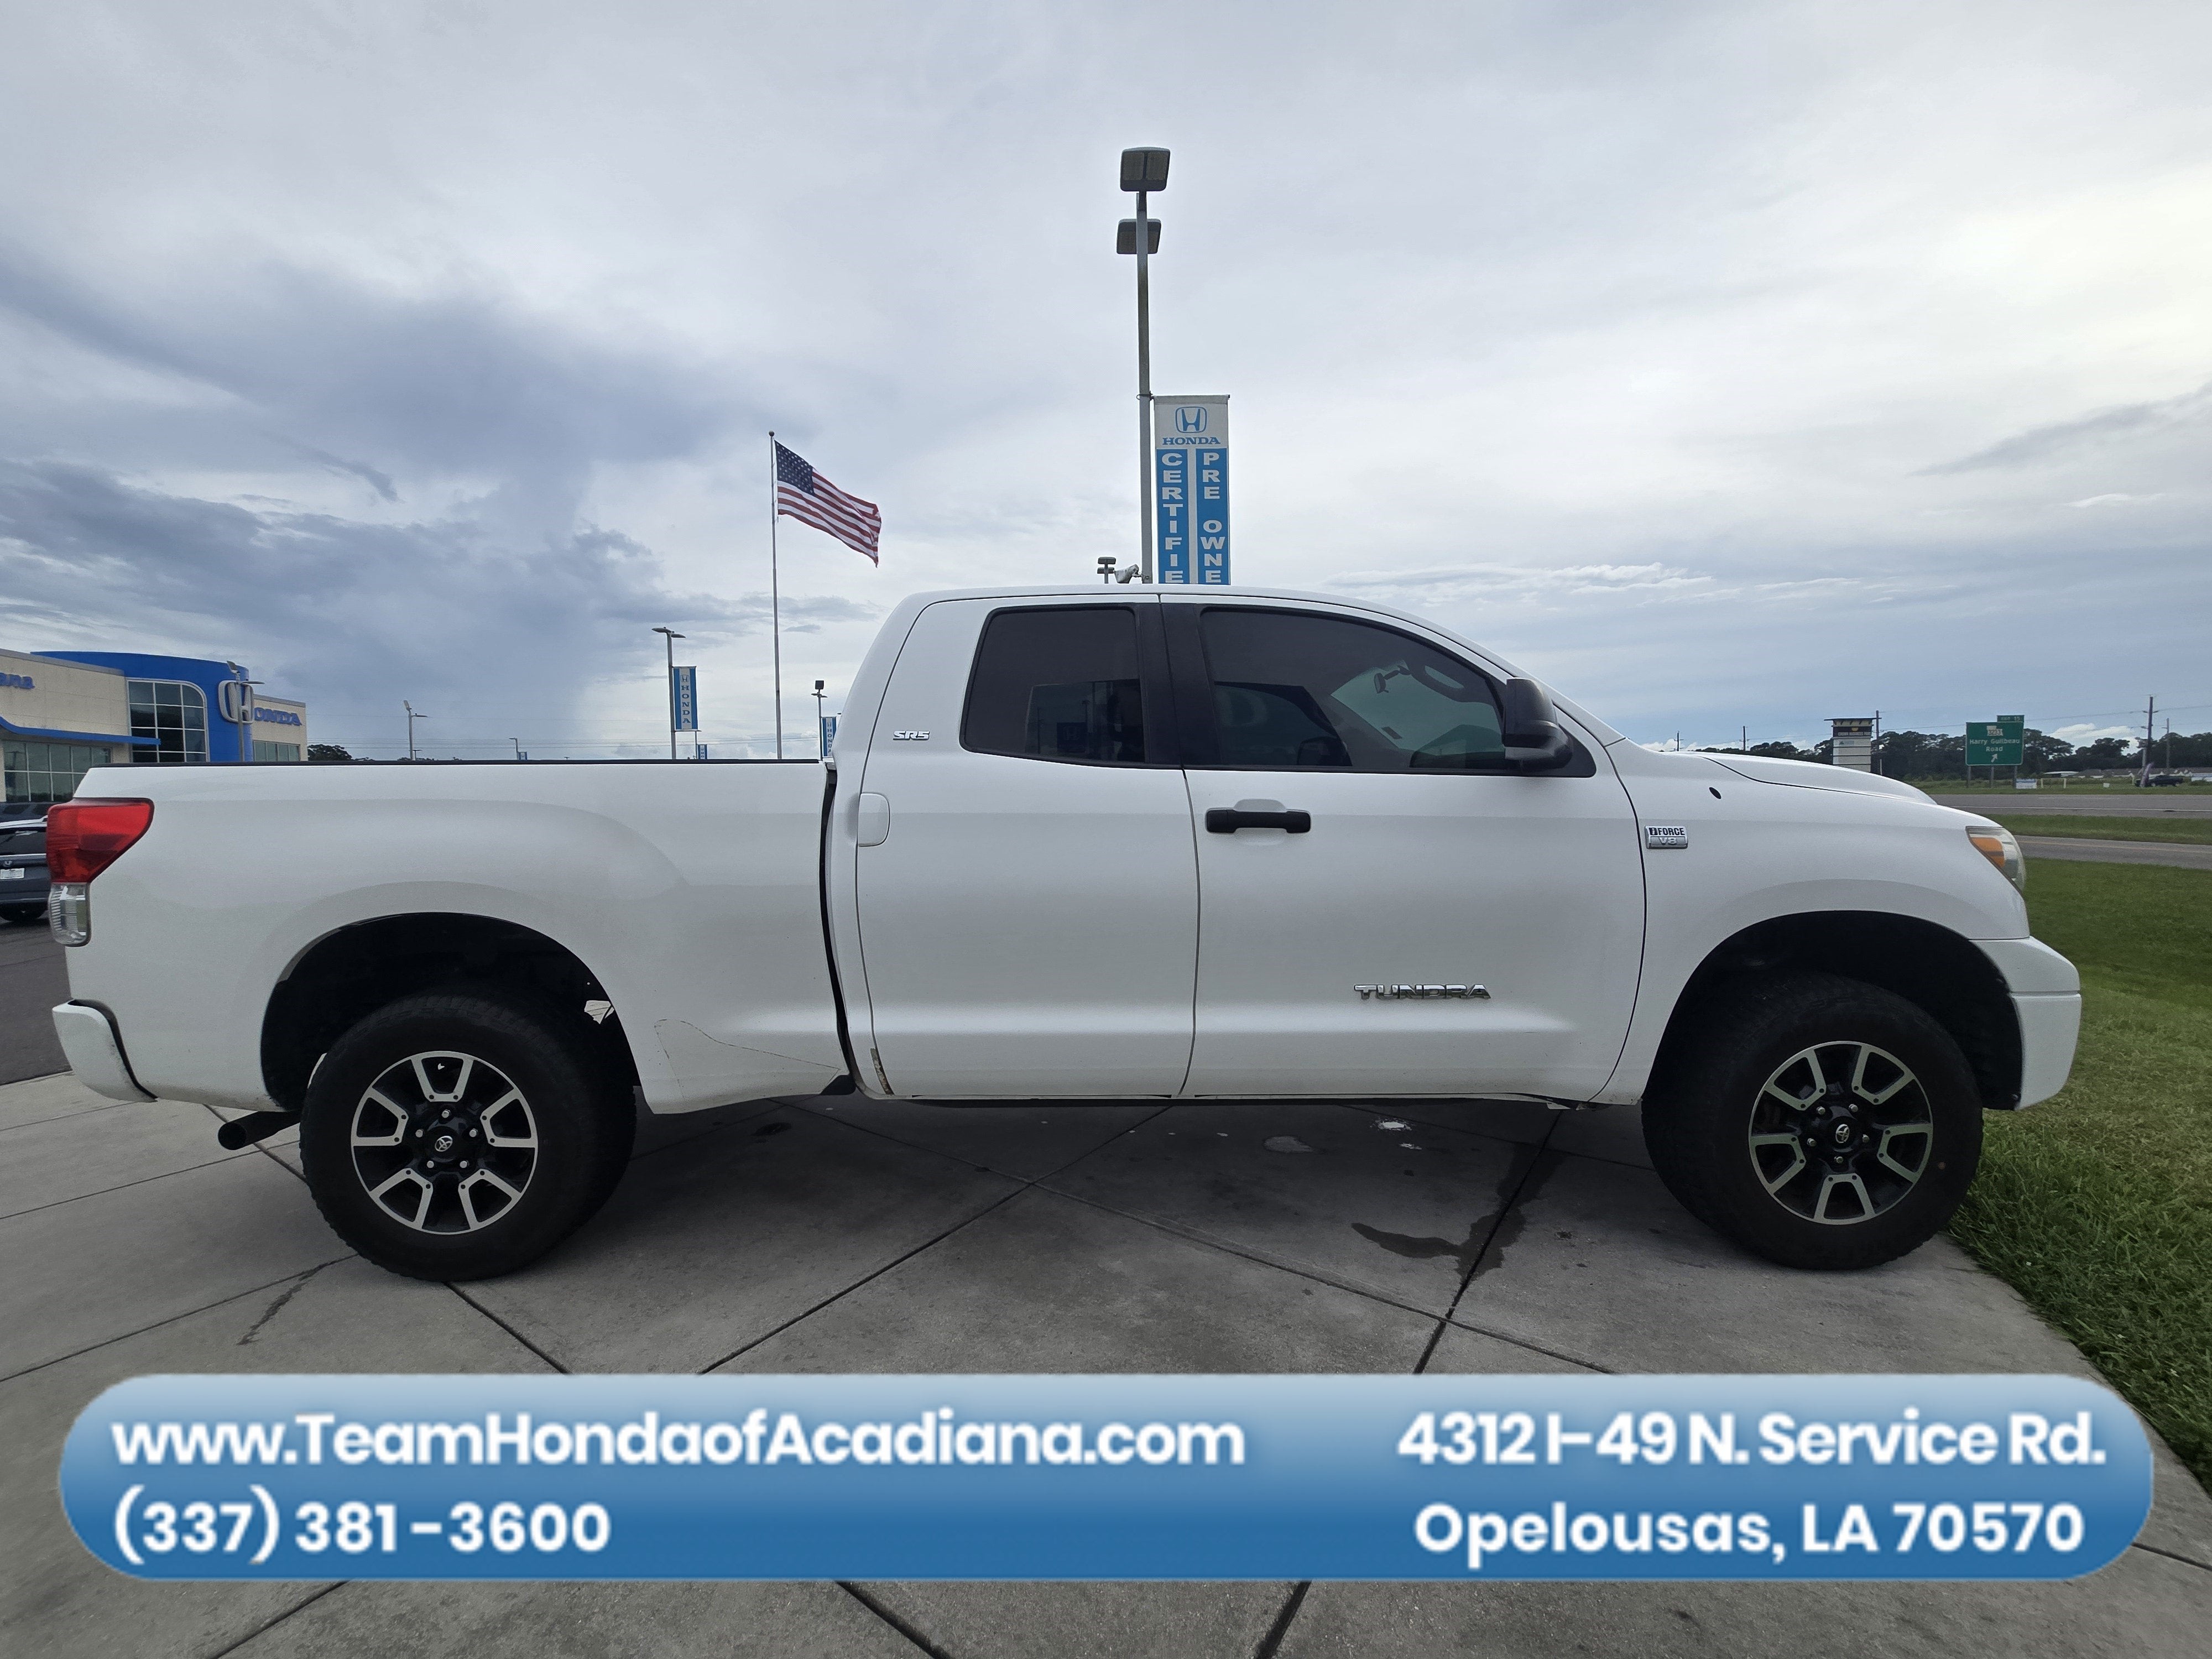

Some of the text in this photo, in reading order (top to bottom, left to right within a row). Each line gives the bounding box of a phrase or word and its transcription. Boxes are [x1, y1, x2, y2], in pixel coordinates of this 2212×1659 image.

[1162, 437, 1220, 445] HONDA
[1161, 452, 1184, 583] CERTIFIE
[1199, 452, 1225, 583] PRE OWNE
[681, 685, 691, 723] HONDA
[254, 707, 302, 726] ONDA
[893, 731, 930, 740] SR5
[1658, 837, 1677, 846] V8
[1354, 984, 1491, 999] TUNDRA
